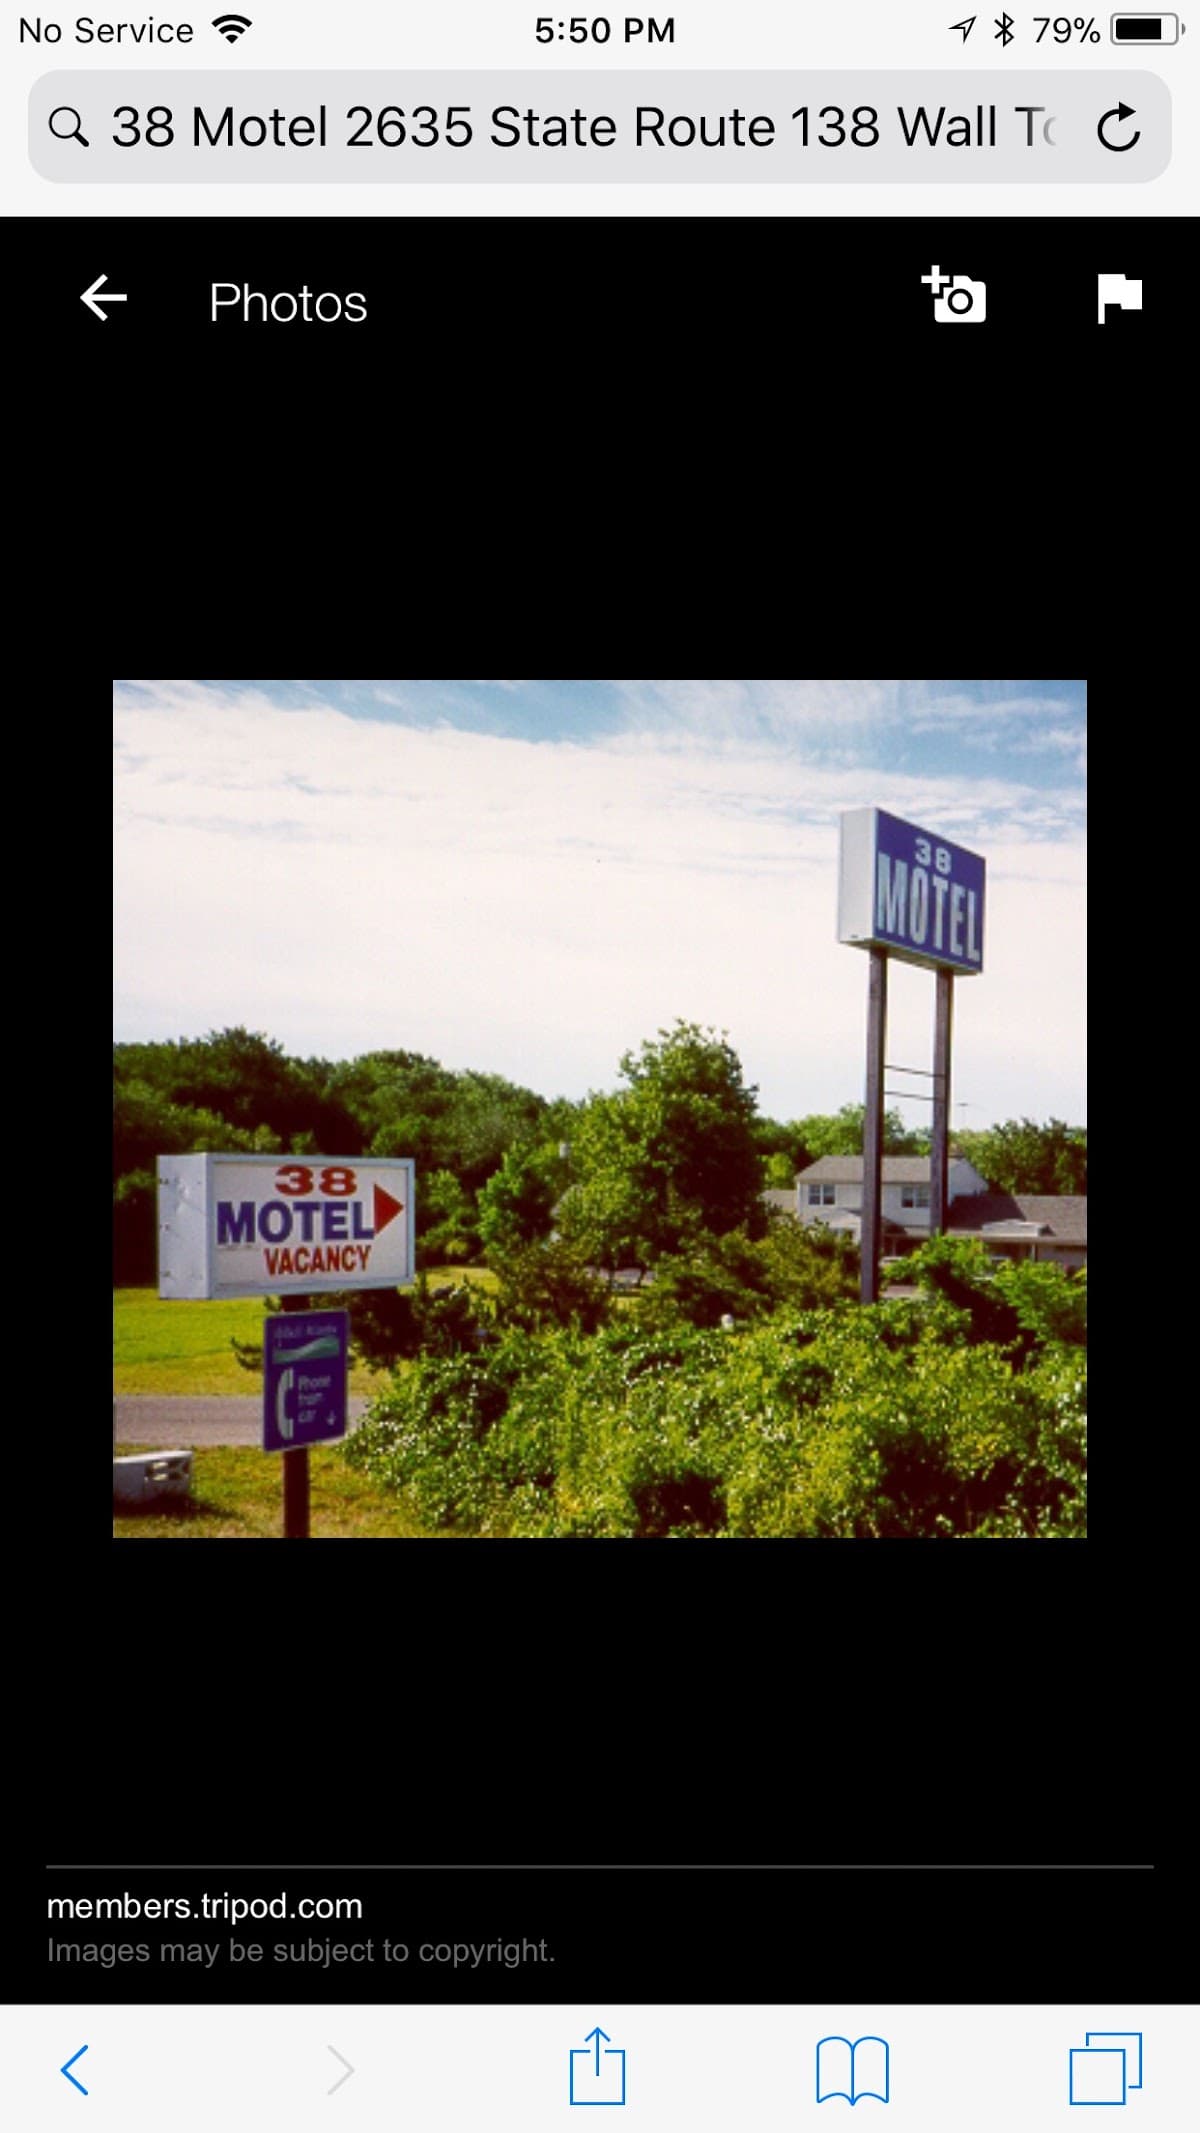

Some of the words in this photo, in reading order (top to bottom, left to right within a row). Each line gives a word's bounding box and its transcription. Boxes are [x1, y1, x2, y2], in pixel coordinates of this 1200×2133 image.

[20, 16, 62, 44] No
[75, 16, 193, 44] Service
[536, 16, 611, 44] 5:50
[625, 16, 675, 44] PM
[1033, 16, 1101, 44] 79%
[113, 105, 175, 148] 38
[194, 105, 327, 148] Motel
[347, 105, 474, 148] 2635
[491, 105, 617, 148] State
[636, 105, 776, 148] Route
[792, 105, 880, 148] 138
[897, 104, 996, 148] Wall
[211, 282, 368, 323] Photos
[914, 836, 952, 875] 38
[877, 852, 981, 962] MOTEL
[274, 1164, 358, 1197] 38
[217, 1201, 375, 1244] MOTEL
[264, 1244, 372, 1276] VACANCY
[47, 1892, 363, 1925] members.tripod.com
[48, 1937, 150, 1969] Images
[161, 1943, 220, 1969] may
[230, 1937, 263, 1962] be
[274, 1937, 374, 1969] subject
[383, 1938, 409, 1962] to
[419, 1937, 555, 1969] copyright.
